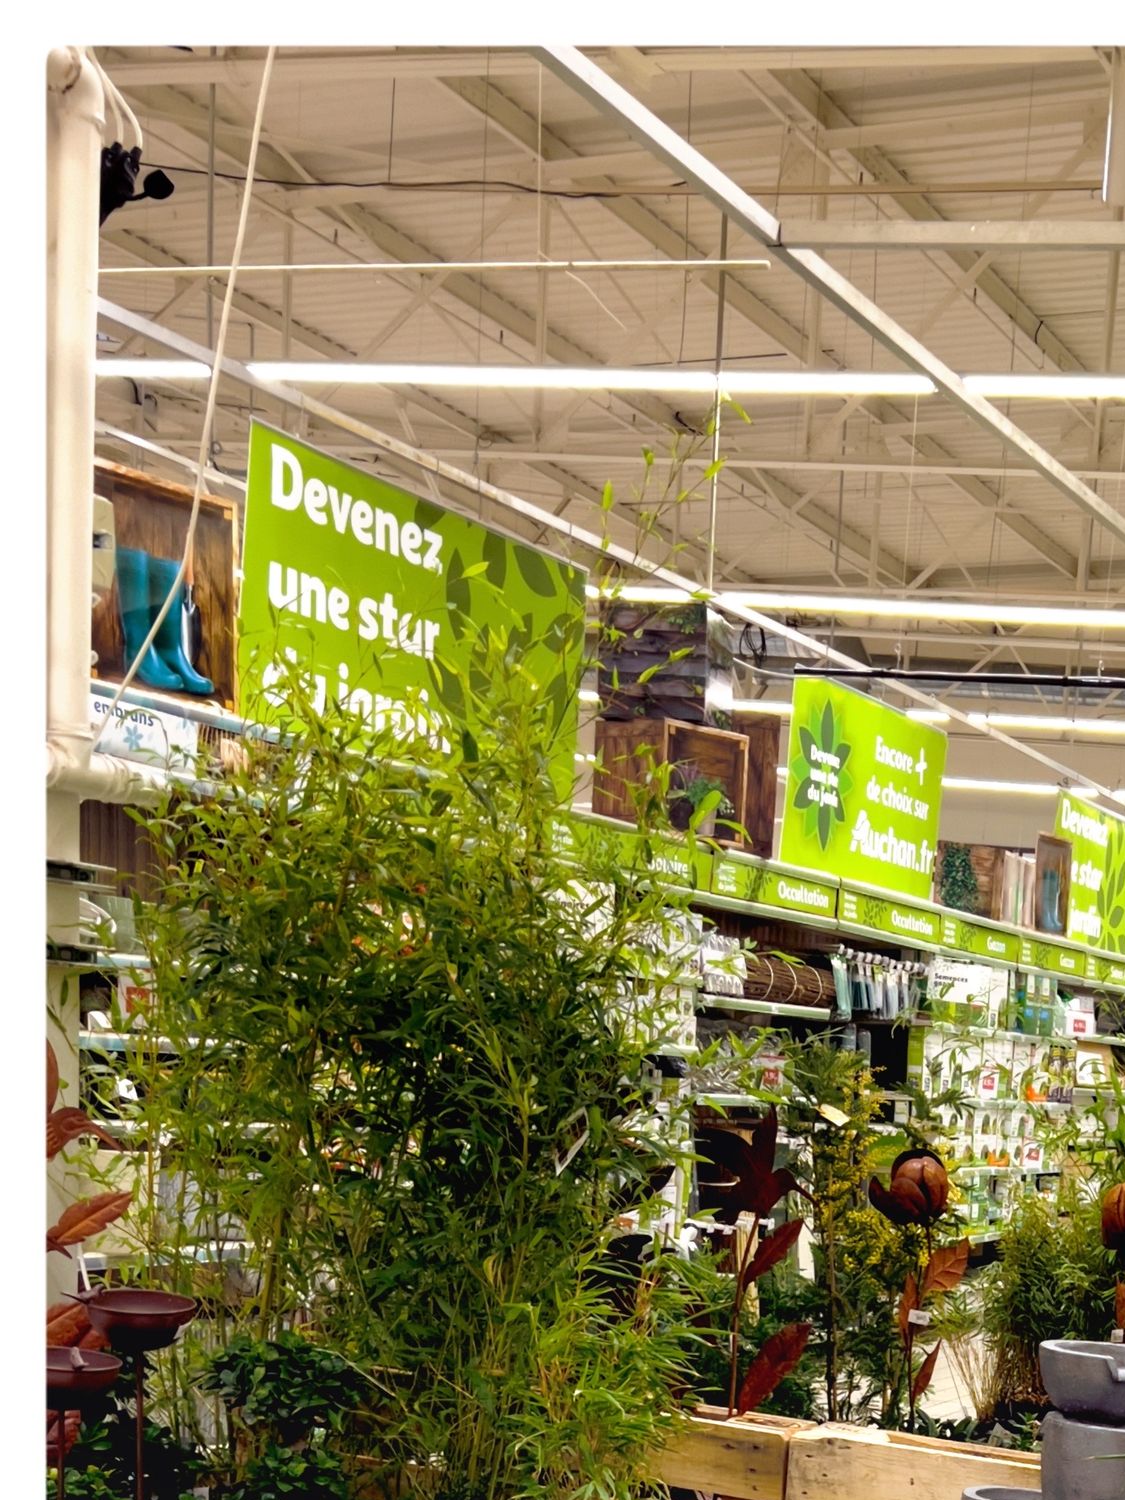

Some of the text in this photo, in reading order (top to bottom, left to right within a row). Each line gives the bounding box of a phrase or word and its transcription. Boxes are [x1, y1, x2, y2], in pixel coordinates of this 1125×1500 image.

[270, 443, 443, 568] Devenez
[268, 560, 440, 660] une star
[874, 735, 914, 775] Encore
[866, 775, 929, 821] de choix sur
[850, 809, 933, 875] Auchan.fr
[778, 880, 829, 909] Occultation
[891, 910, 933, 936] Occultation
